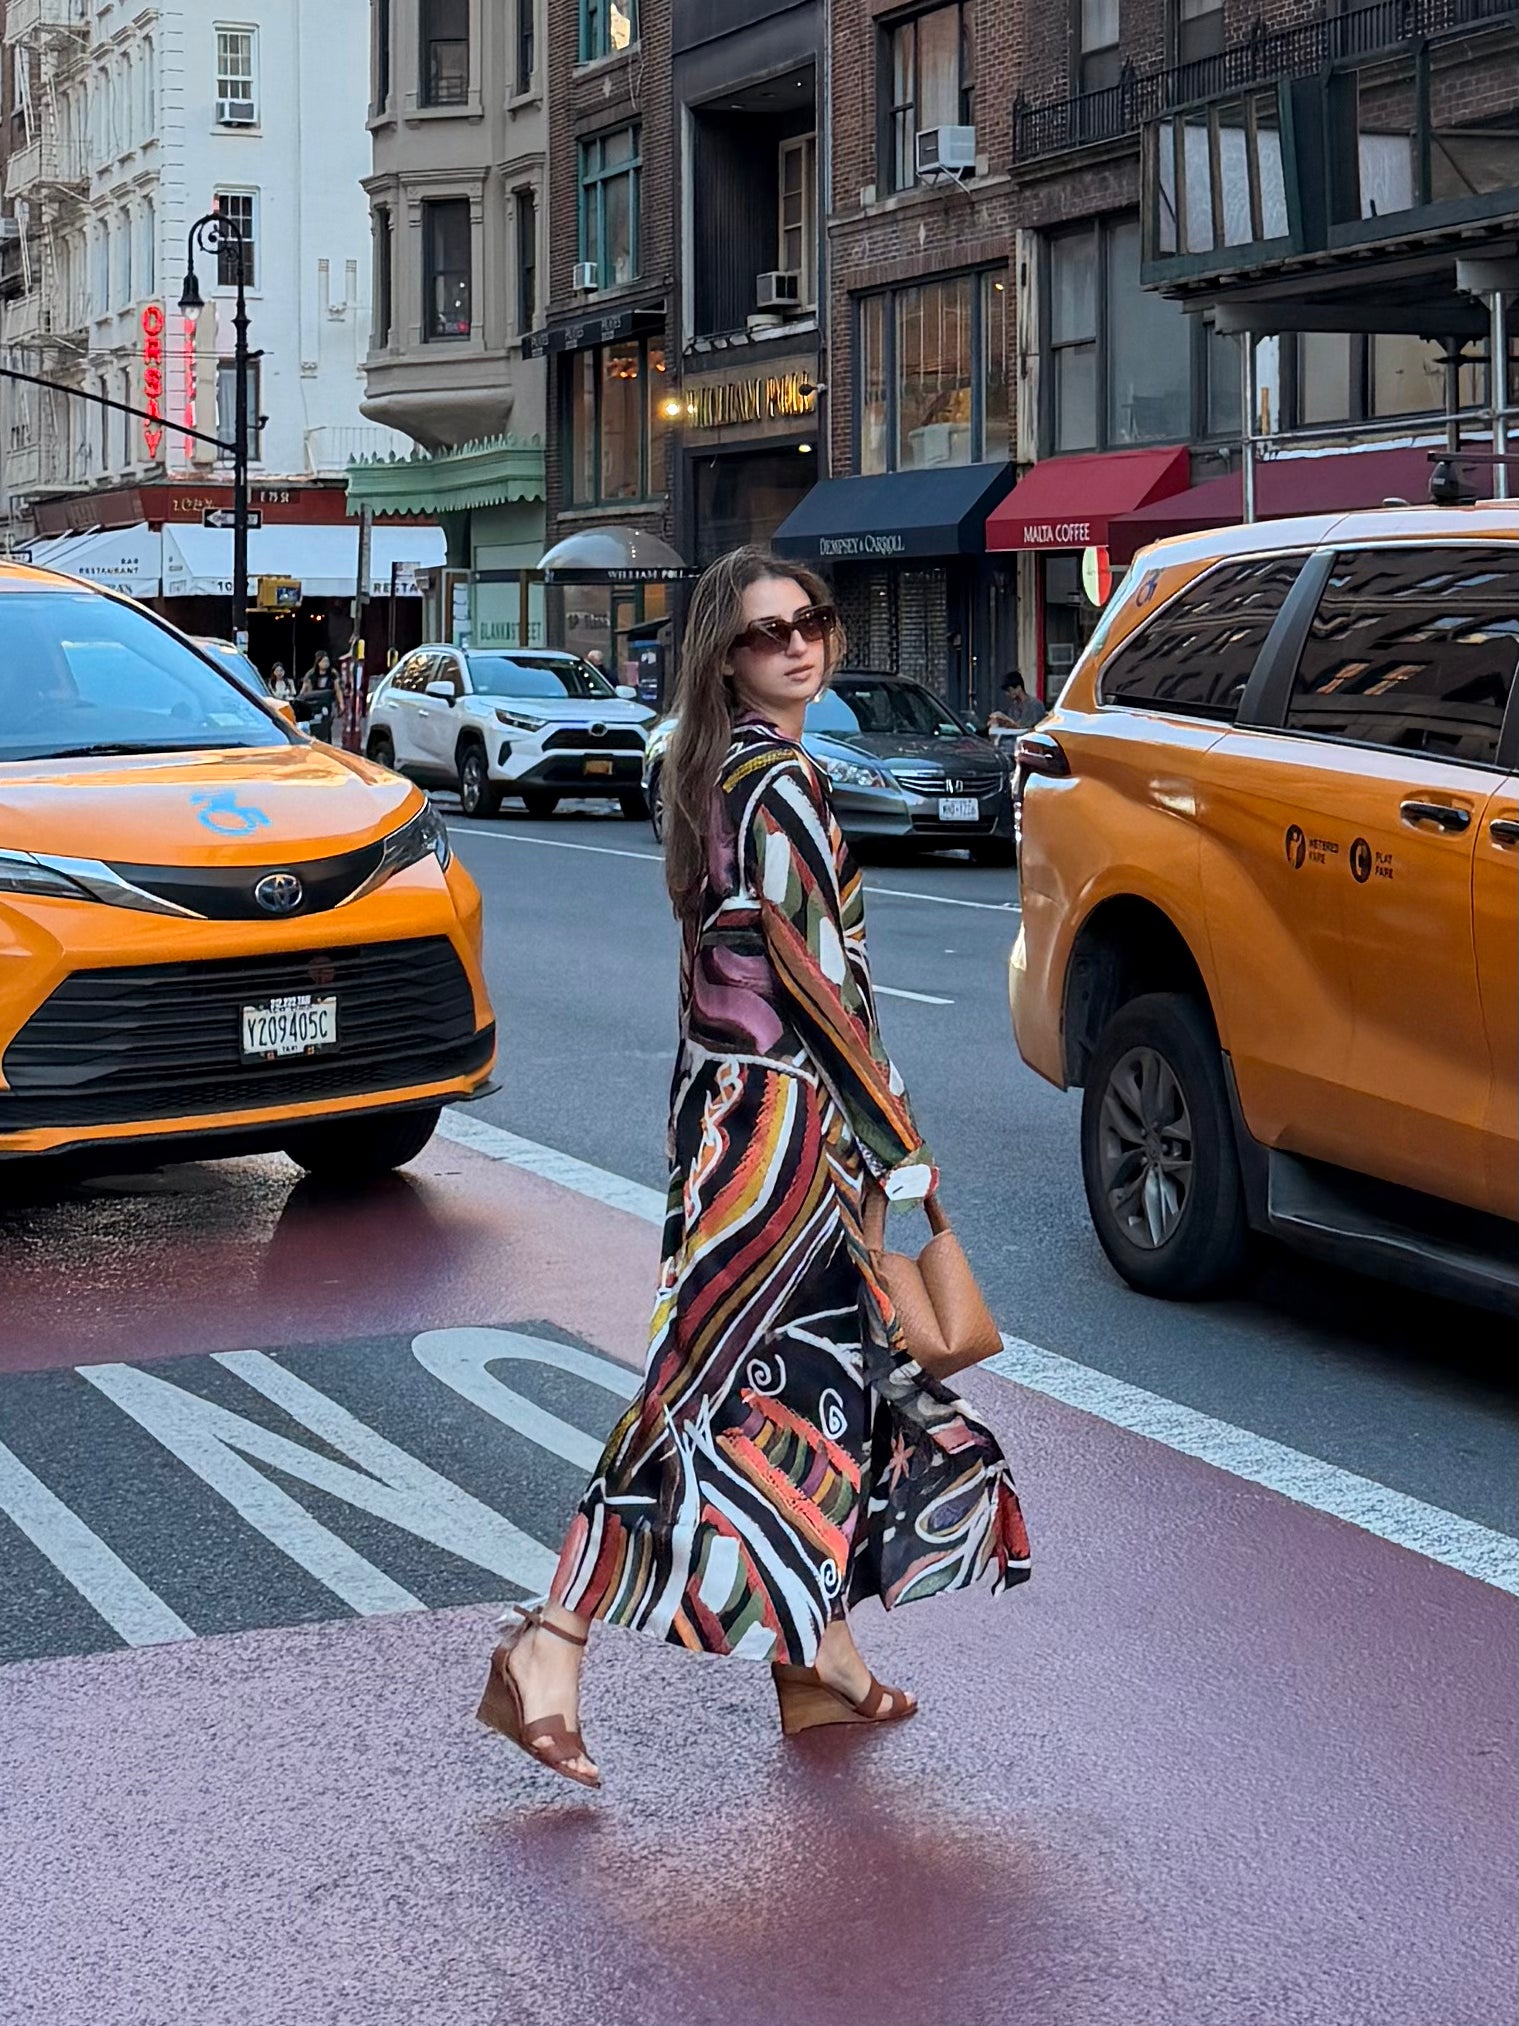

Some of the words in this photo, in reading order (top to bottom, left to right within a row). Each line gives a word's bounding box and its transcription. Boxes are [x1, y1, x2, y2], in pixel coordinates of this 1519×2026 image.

[141, 305, 164, 459] ORSAY
[1023, 524, 1054, 543] MALTA
[1055, 522, 1091, 542] COFFEE
[819, 537, 859, 556] DEMPSEY
[864, 534, 905, 555] CARROLL
[79, 566, 139, 574] RESTAURANT
[607, 569, 658, 580] WILLIAM
[480, 621, 506, 641] BLANK
[510, 621, 542, 641] STEET
[247, 1010, 328, 1048] Y209405C
